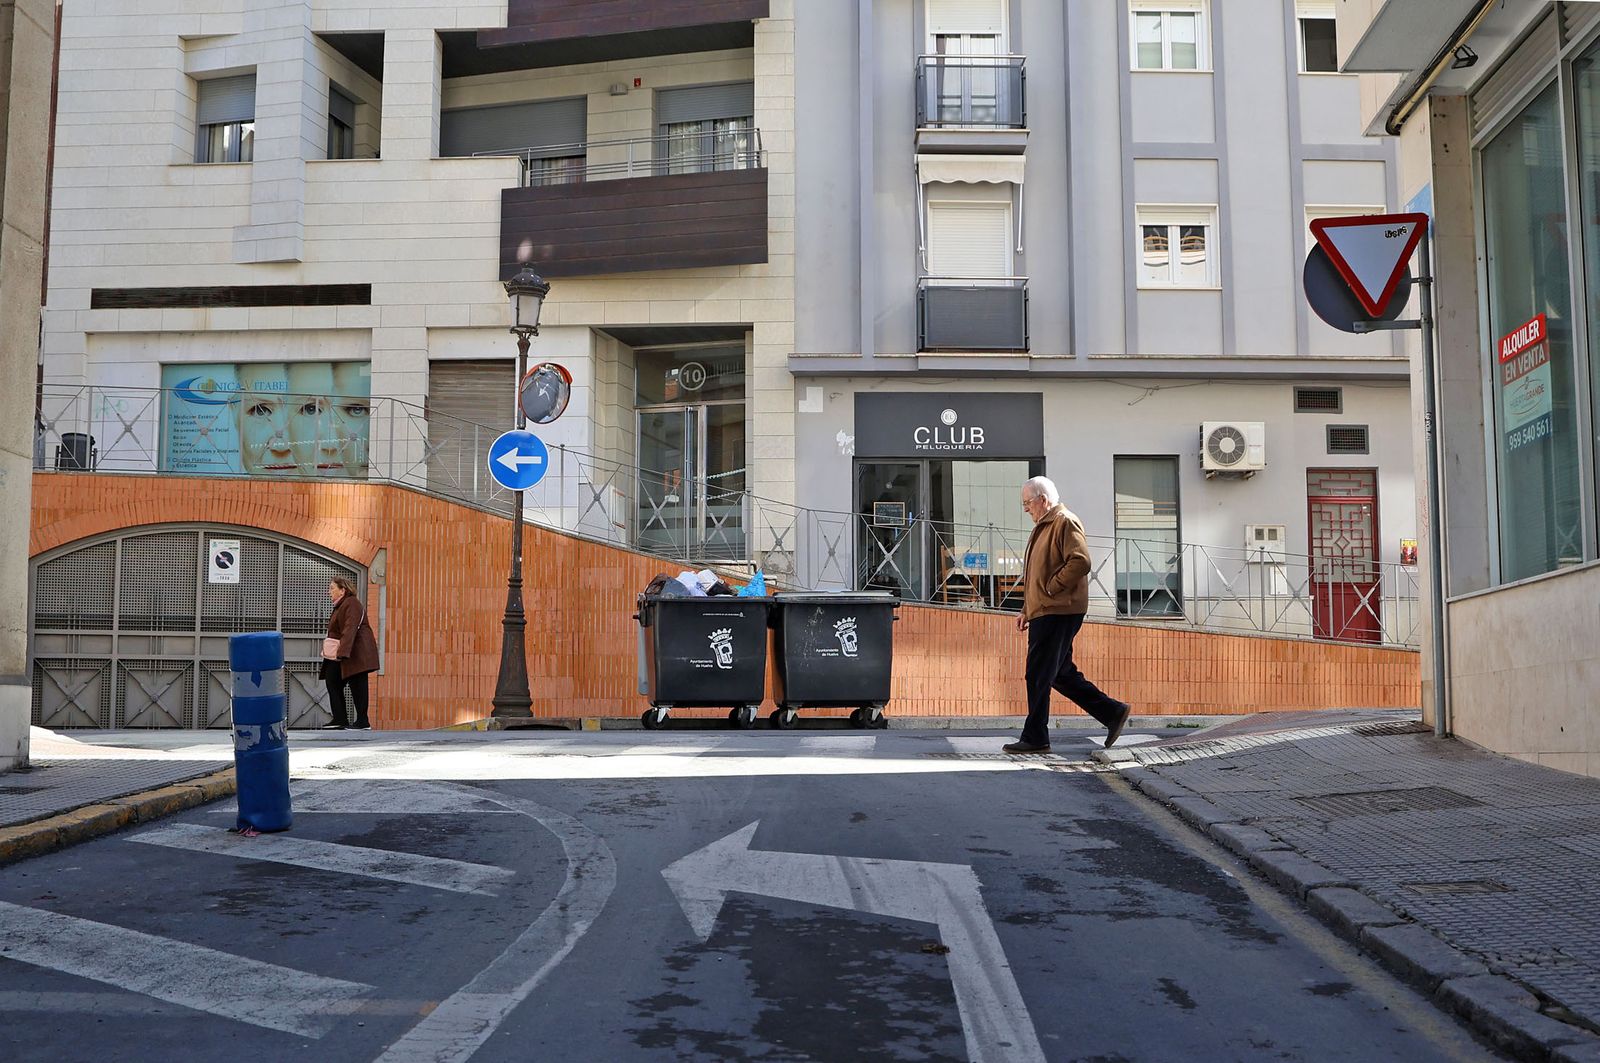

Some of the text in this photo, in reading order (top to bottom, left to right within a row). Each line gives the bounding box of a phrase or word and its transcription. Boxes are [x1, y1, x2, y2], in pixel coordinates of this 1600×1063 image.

[1503, 321, 1539, 357] ALQUILER
[683, 370, 701, 383] 10
[1505, 346, 1545, 381] EN VENTA
[914, 427, 985, 444] CLUB
[1509, 420, 1548, 450] 959 540 561
